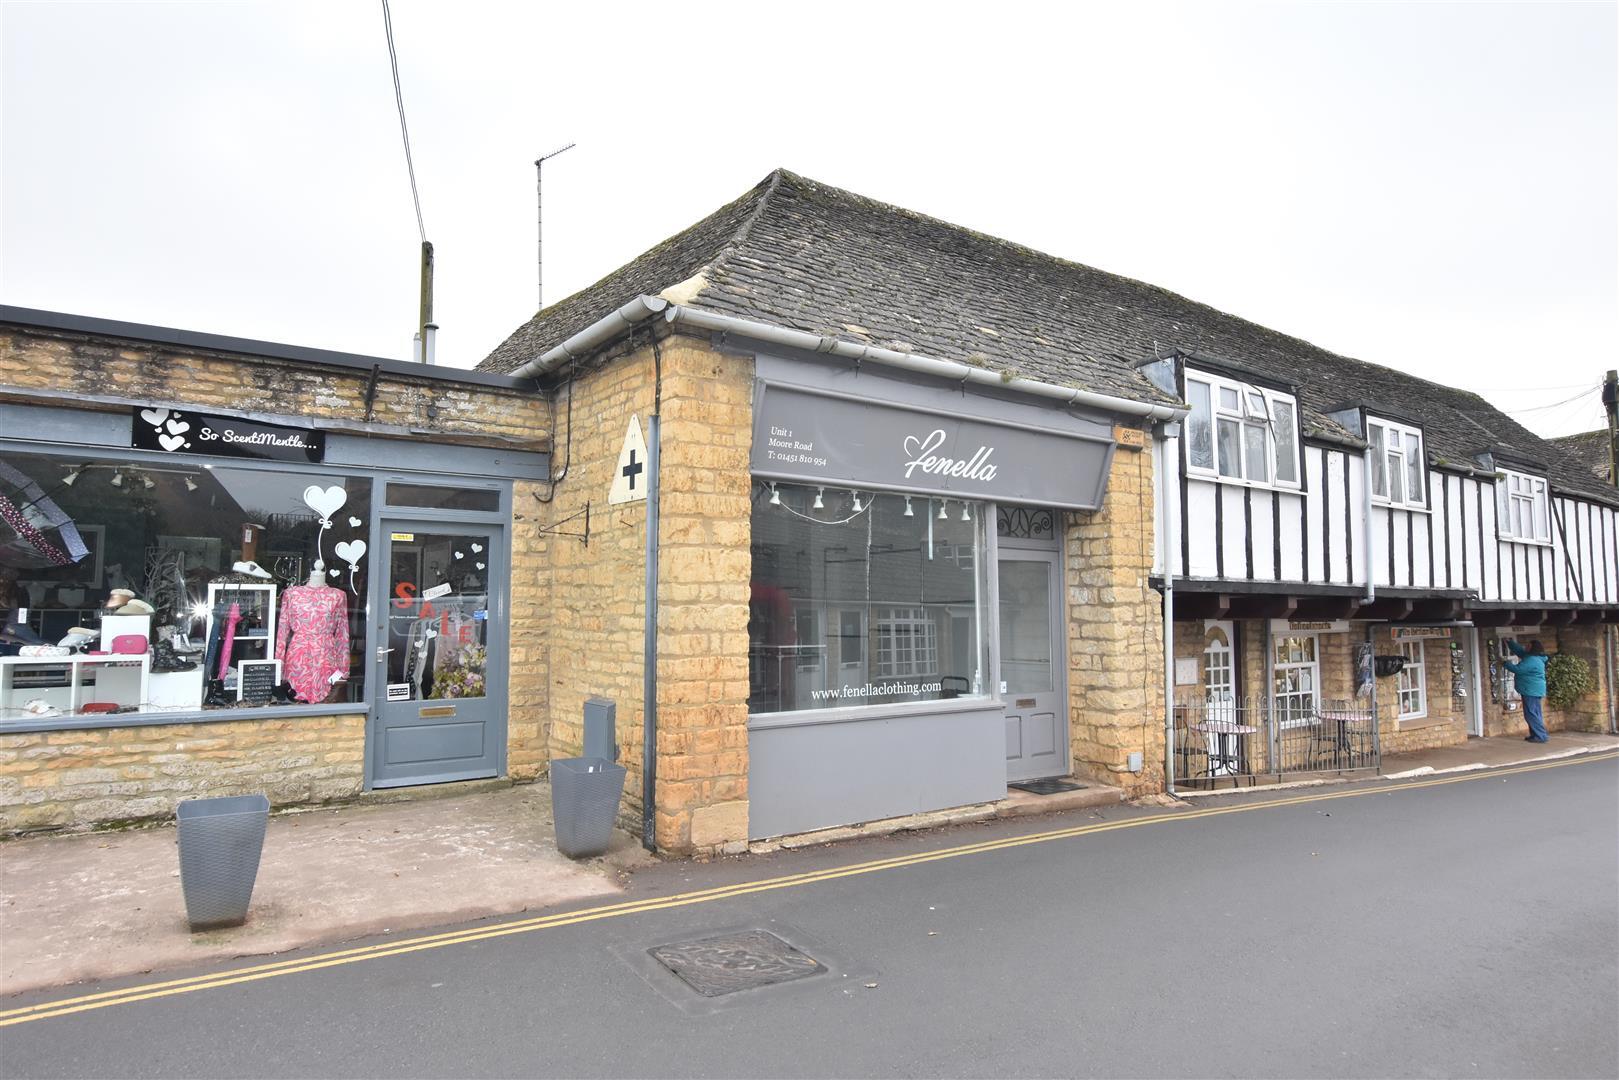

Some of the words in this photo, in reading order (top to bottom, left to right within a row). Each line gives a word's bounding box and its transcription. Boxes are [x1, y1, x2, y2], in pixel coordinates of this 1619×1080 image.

[199, 427, 219, 441] So
[771, 426, 787, 437] Unit
[768, 438, 793, 449] Moore
[794, 441, 812, 451] Road
[768, 450, 776, 459] T:
[777, 453, 798, 463] 01451
[800, 454, 812, 464] 810
[813, 457, 827, 466] 954
[811, 681, 942, 700] www.fenellaclothing.com
